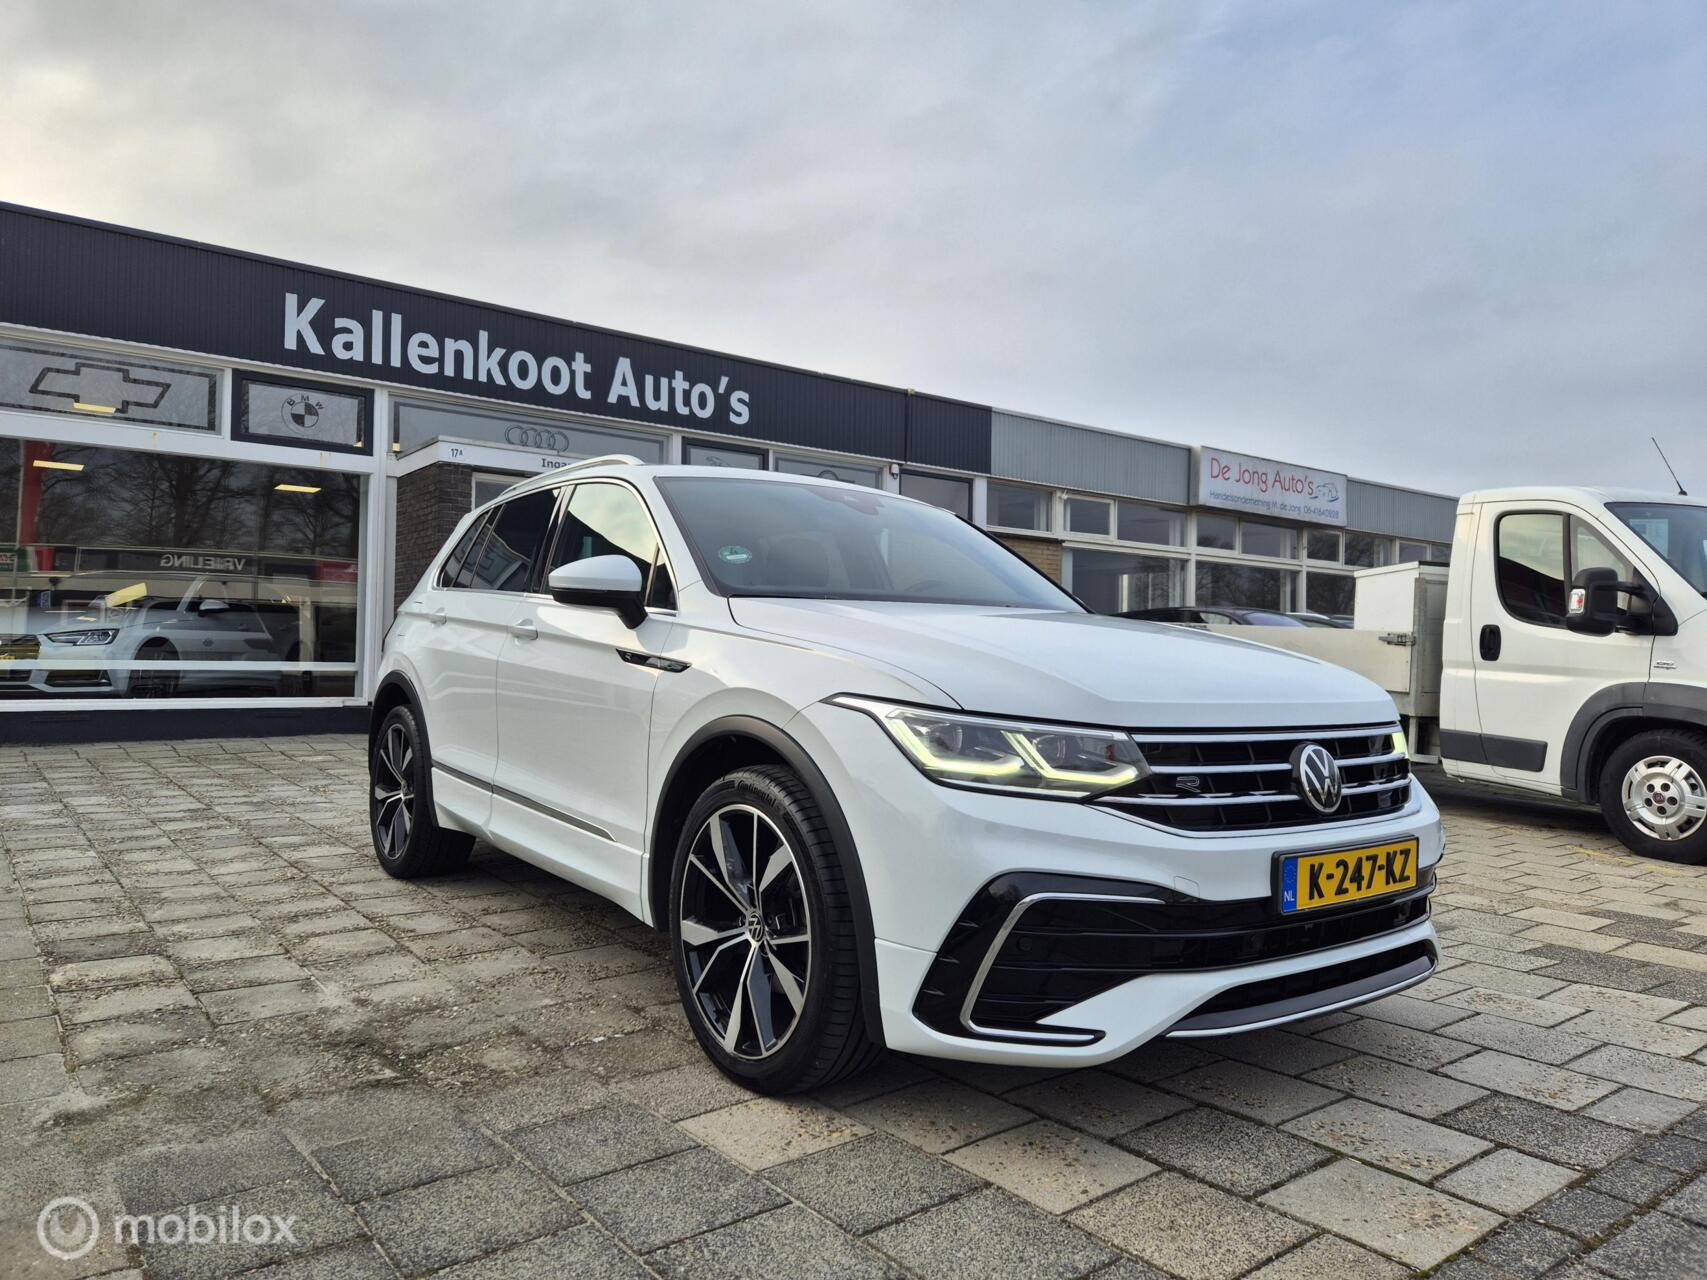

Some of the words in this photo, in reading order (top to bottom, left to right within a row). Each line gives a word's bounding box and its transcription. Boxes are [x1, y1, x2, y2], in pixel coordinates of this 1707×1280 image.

[283, 292, 592, 400] Kallenkoot
[607, 356, 750, 425] Auto's
[1210, 457, 1231, 480] De
[1234, 463, 1268, 493] Jong
[1272, 470, 1314, 496] Auto's
[1283, 890, 1296, 903] NL
[1308, 847, 1412, 901] K-247-KZ
